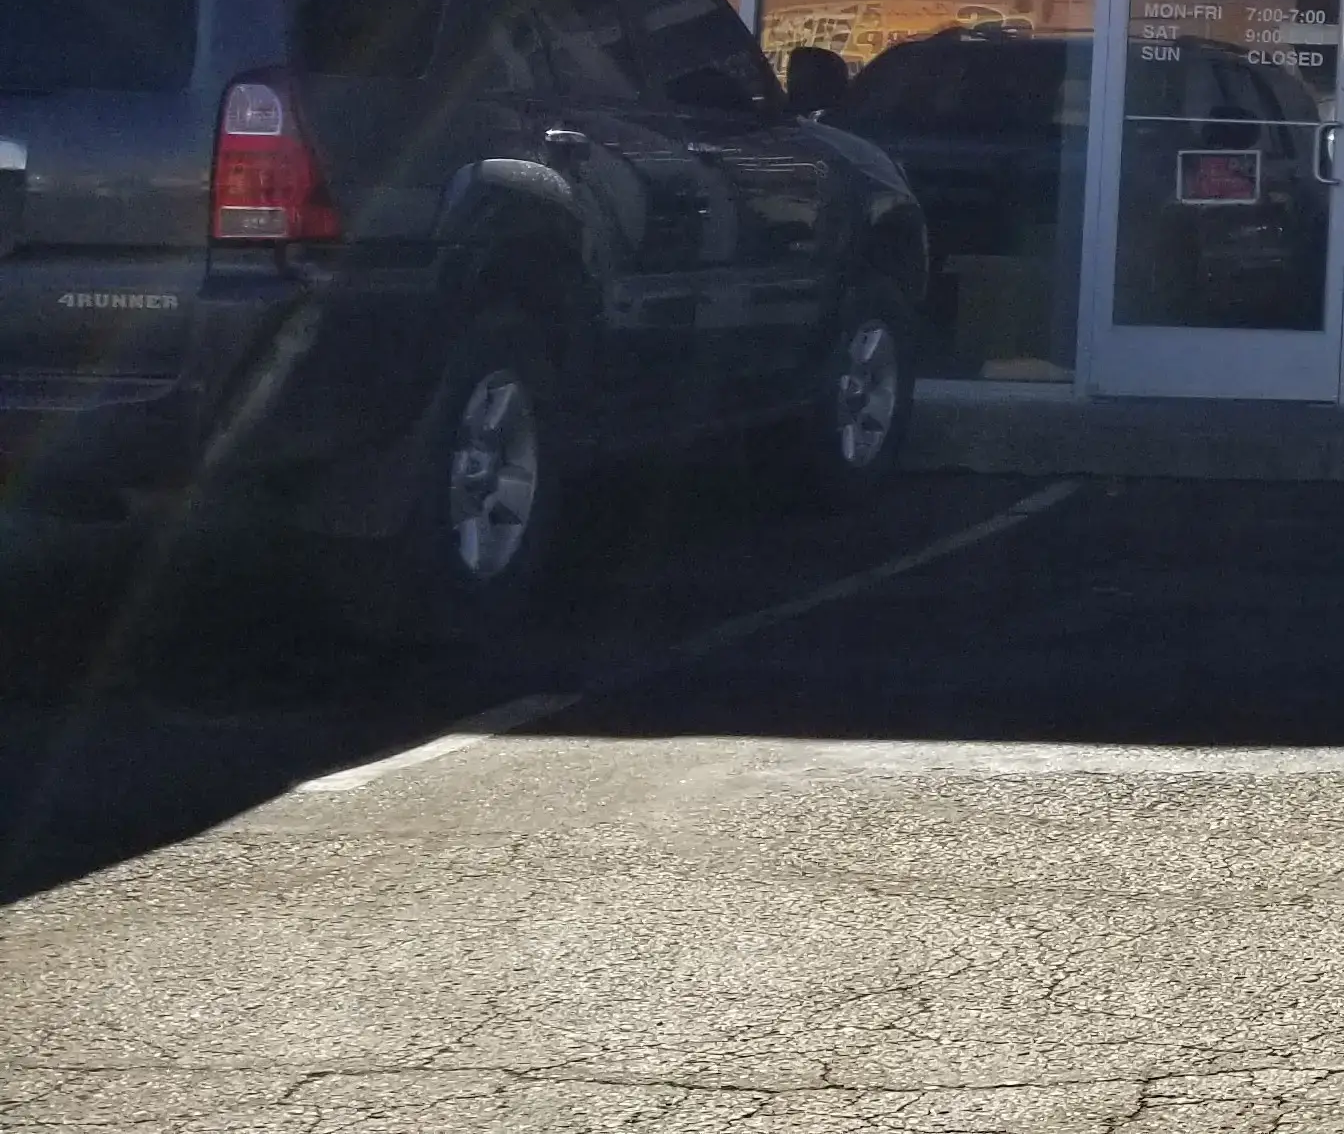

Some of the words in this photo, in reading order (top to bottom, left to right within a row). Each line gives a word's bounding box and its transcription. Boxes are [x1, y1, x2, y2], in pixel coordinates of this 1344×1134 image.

[1143, 3, 1223, 20] MON-FRI
[1245, 6, 1326, 24] 7:00-7:00
[1142, 25, 1179, 41] SAT
[1140, 46, 1181, 62] SUN
[1246, 49, 1324, 67] CLOSED
[57, 292, 179, 309] 4RUNNER
